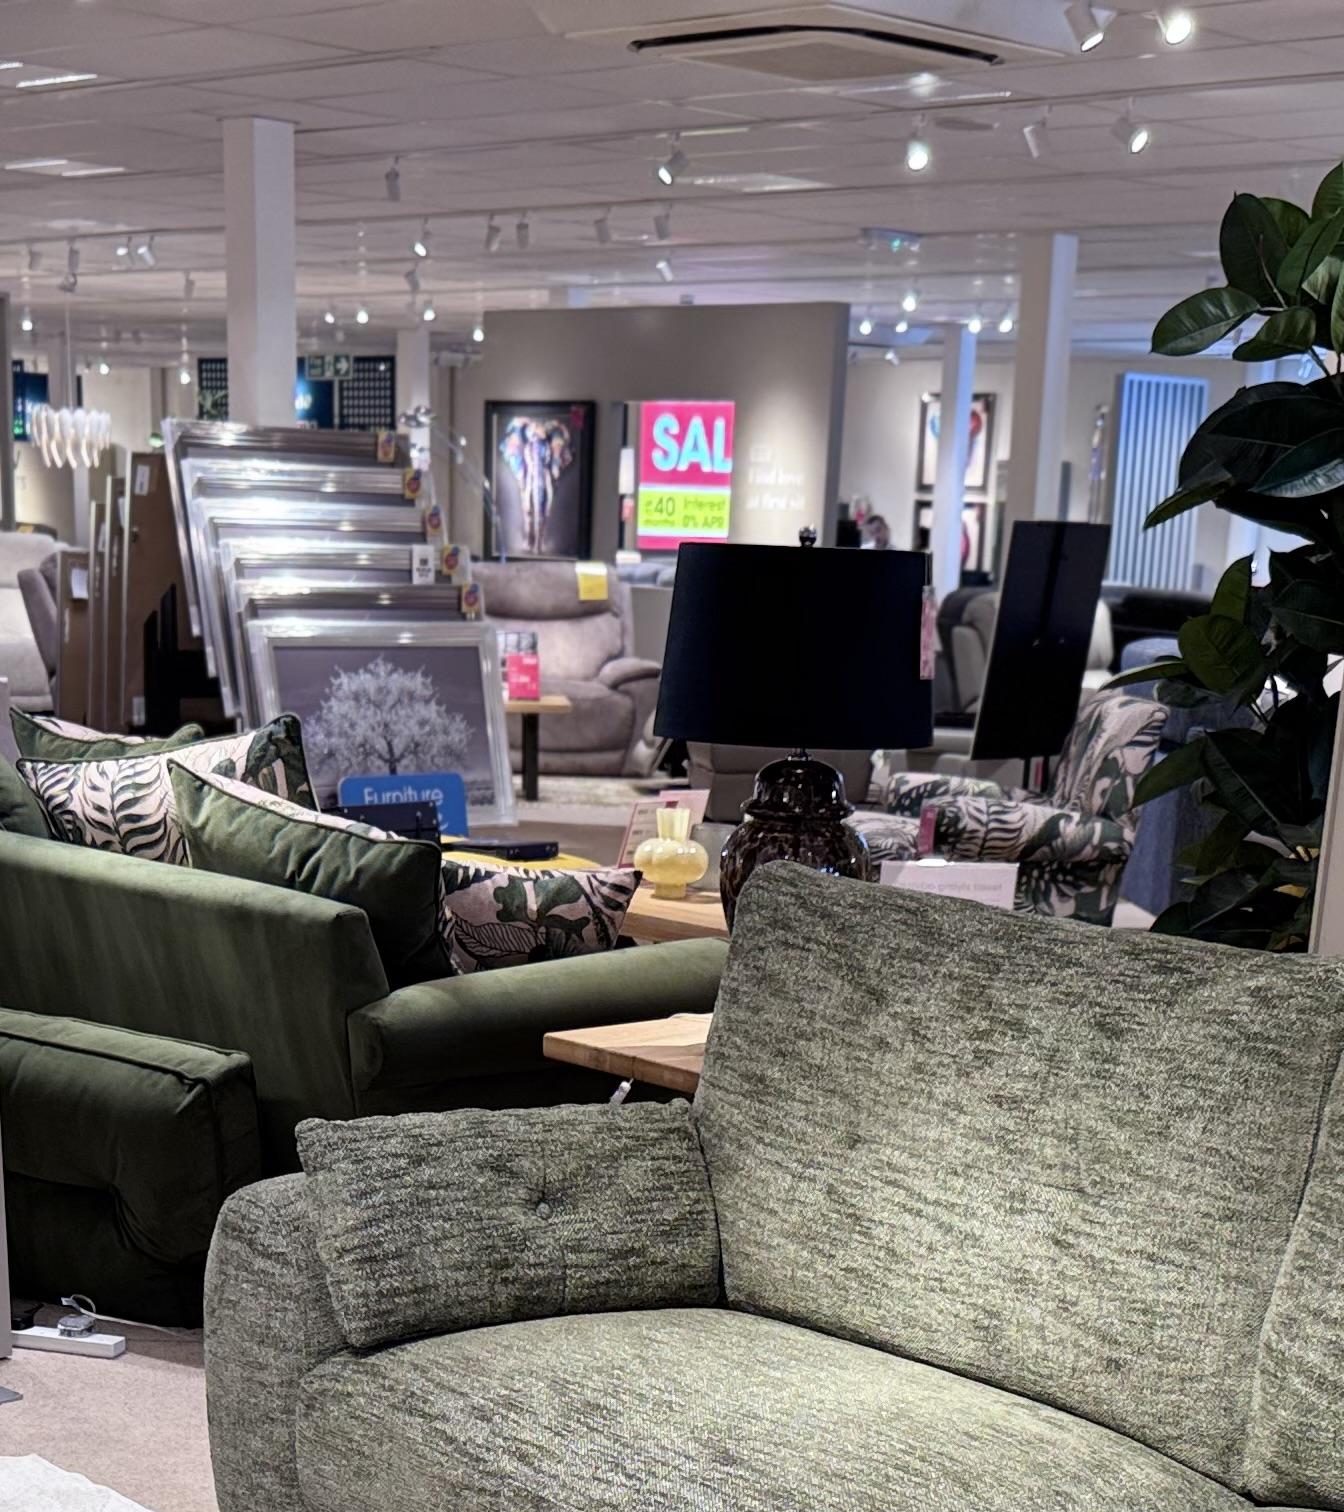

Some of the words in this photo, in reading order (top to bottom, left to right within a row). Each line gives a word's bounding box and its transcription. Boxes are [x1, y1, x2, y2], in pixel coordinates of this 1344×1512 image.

[652, 412, 733, 473] SAL
[654, 497, 675, 517] 40
[364, 786, 444, 805] Furniture
